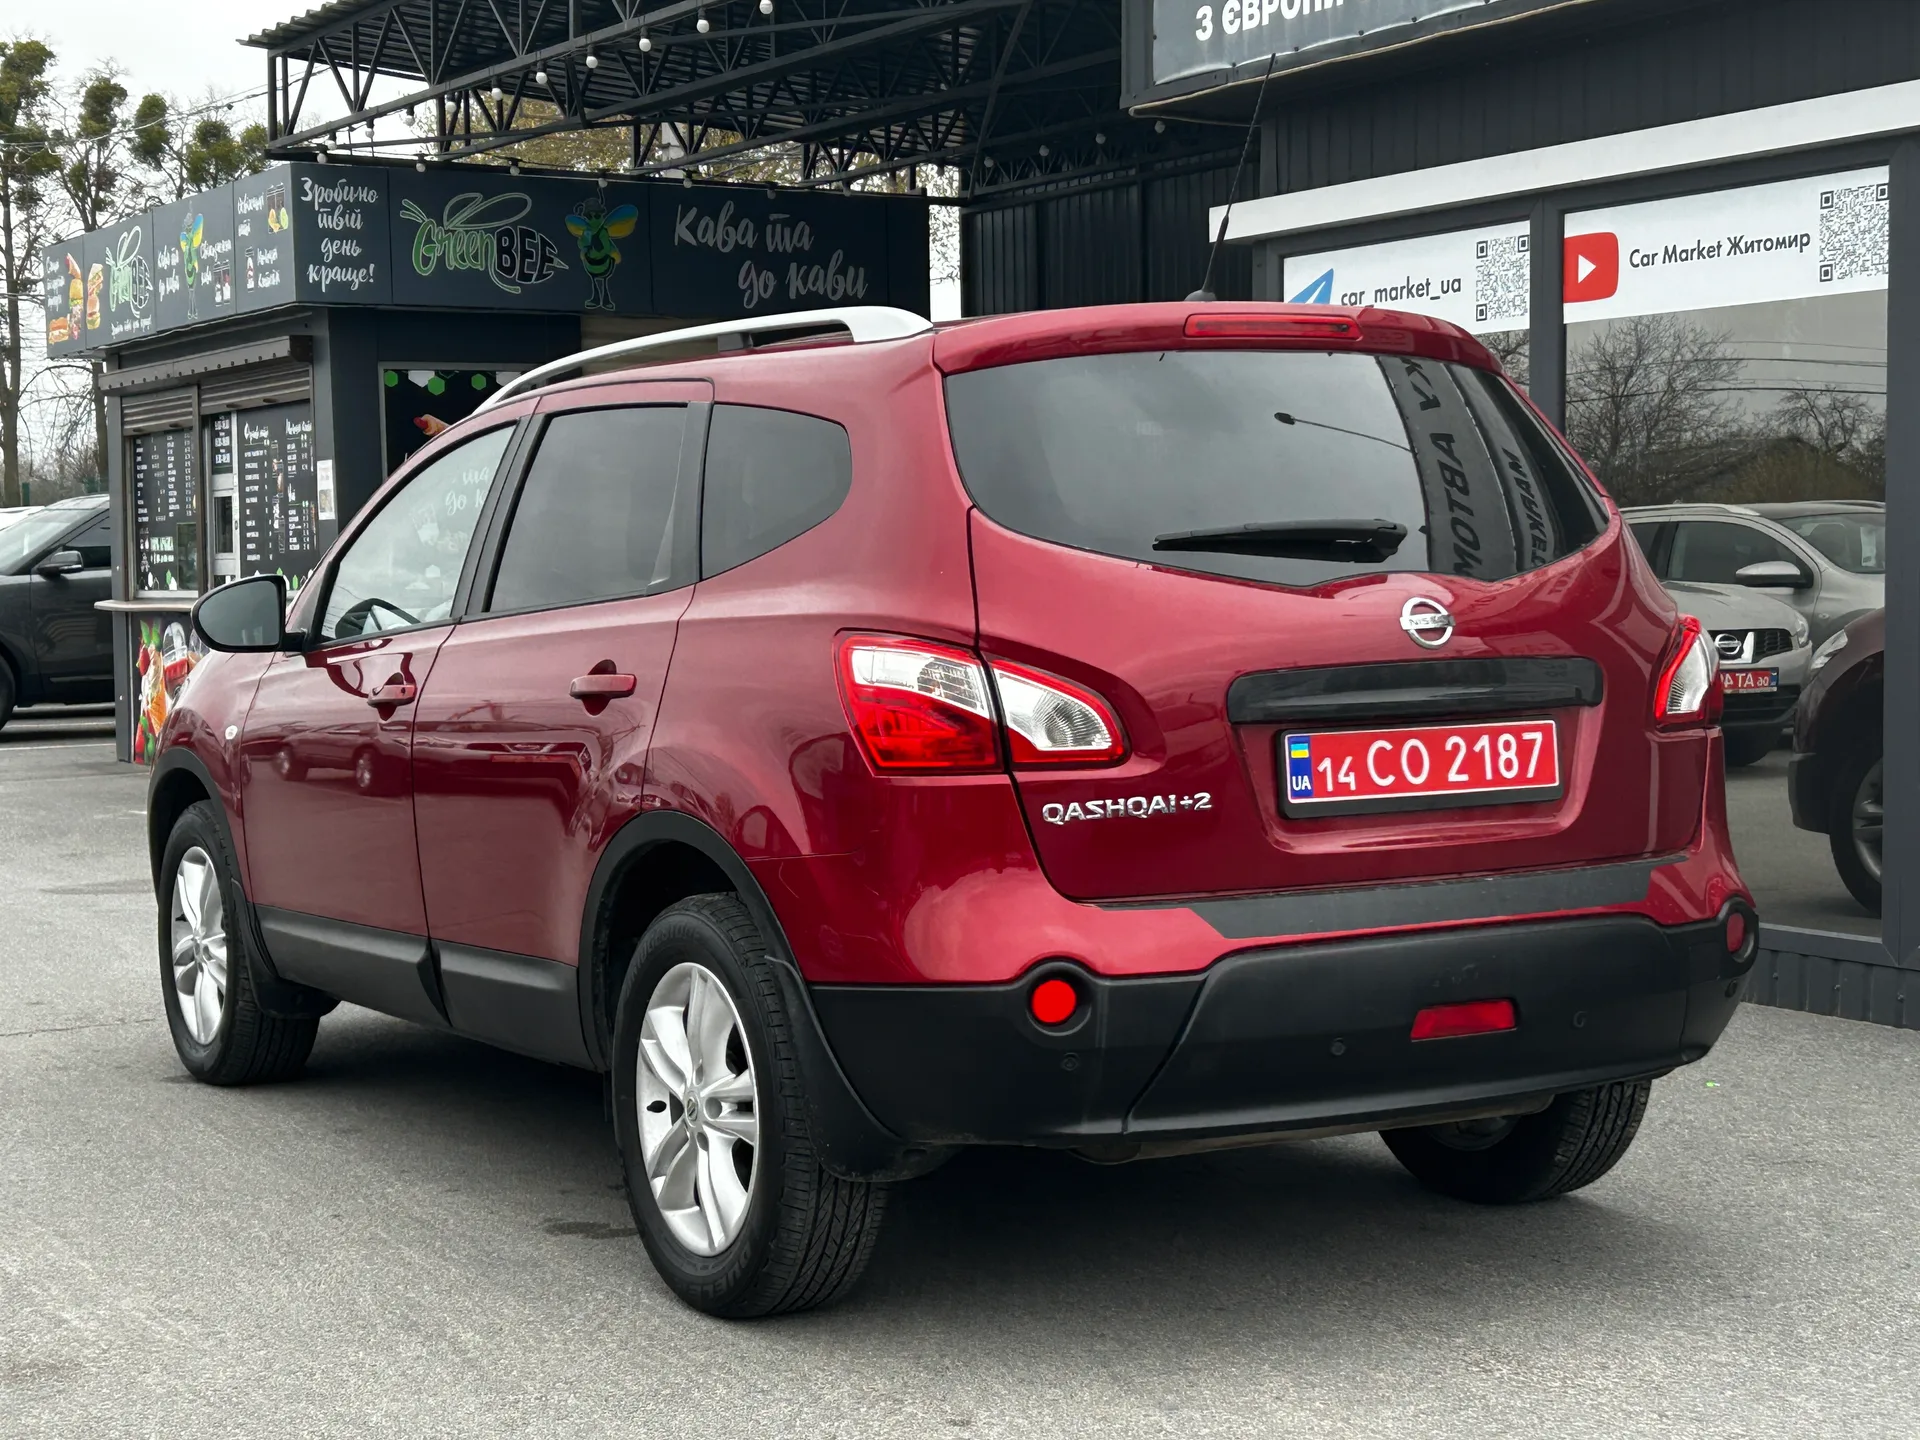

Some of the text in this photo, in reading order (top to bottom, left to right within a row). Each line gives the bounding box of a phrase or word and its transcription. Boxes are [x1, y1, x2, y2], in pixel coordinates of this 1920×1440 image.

[1195, 0, 1343, 41] З ЄВРО
[674, 200, 814, 253] Кава та
[321, 237, 362, 263] день
[1629, 233, 1811, 268] Car Market Житомир
[307, 263, 375, 293] краще!
[738, 249, 868, 309] до кави
[1316, 731, 1543, 792] 14 CO 2187
[1292, 775, 1311, 791] UA
